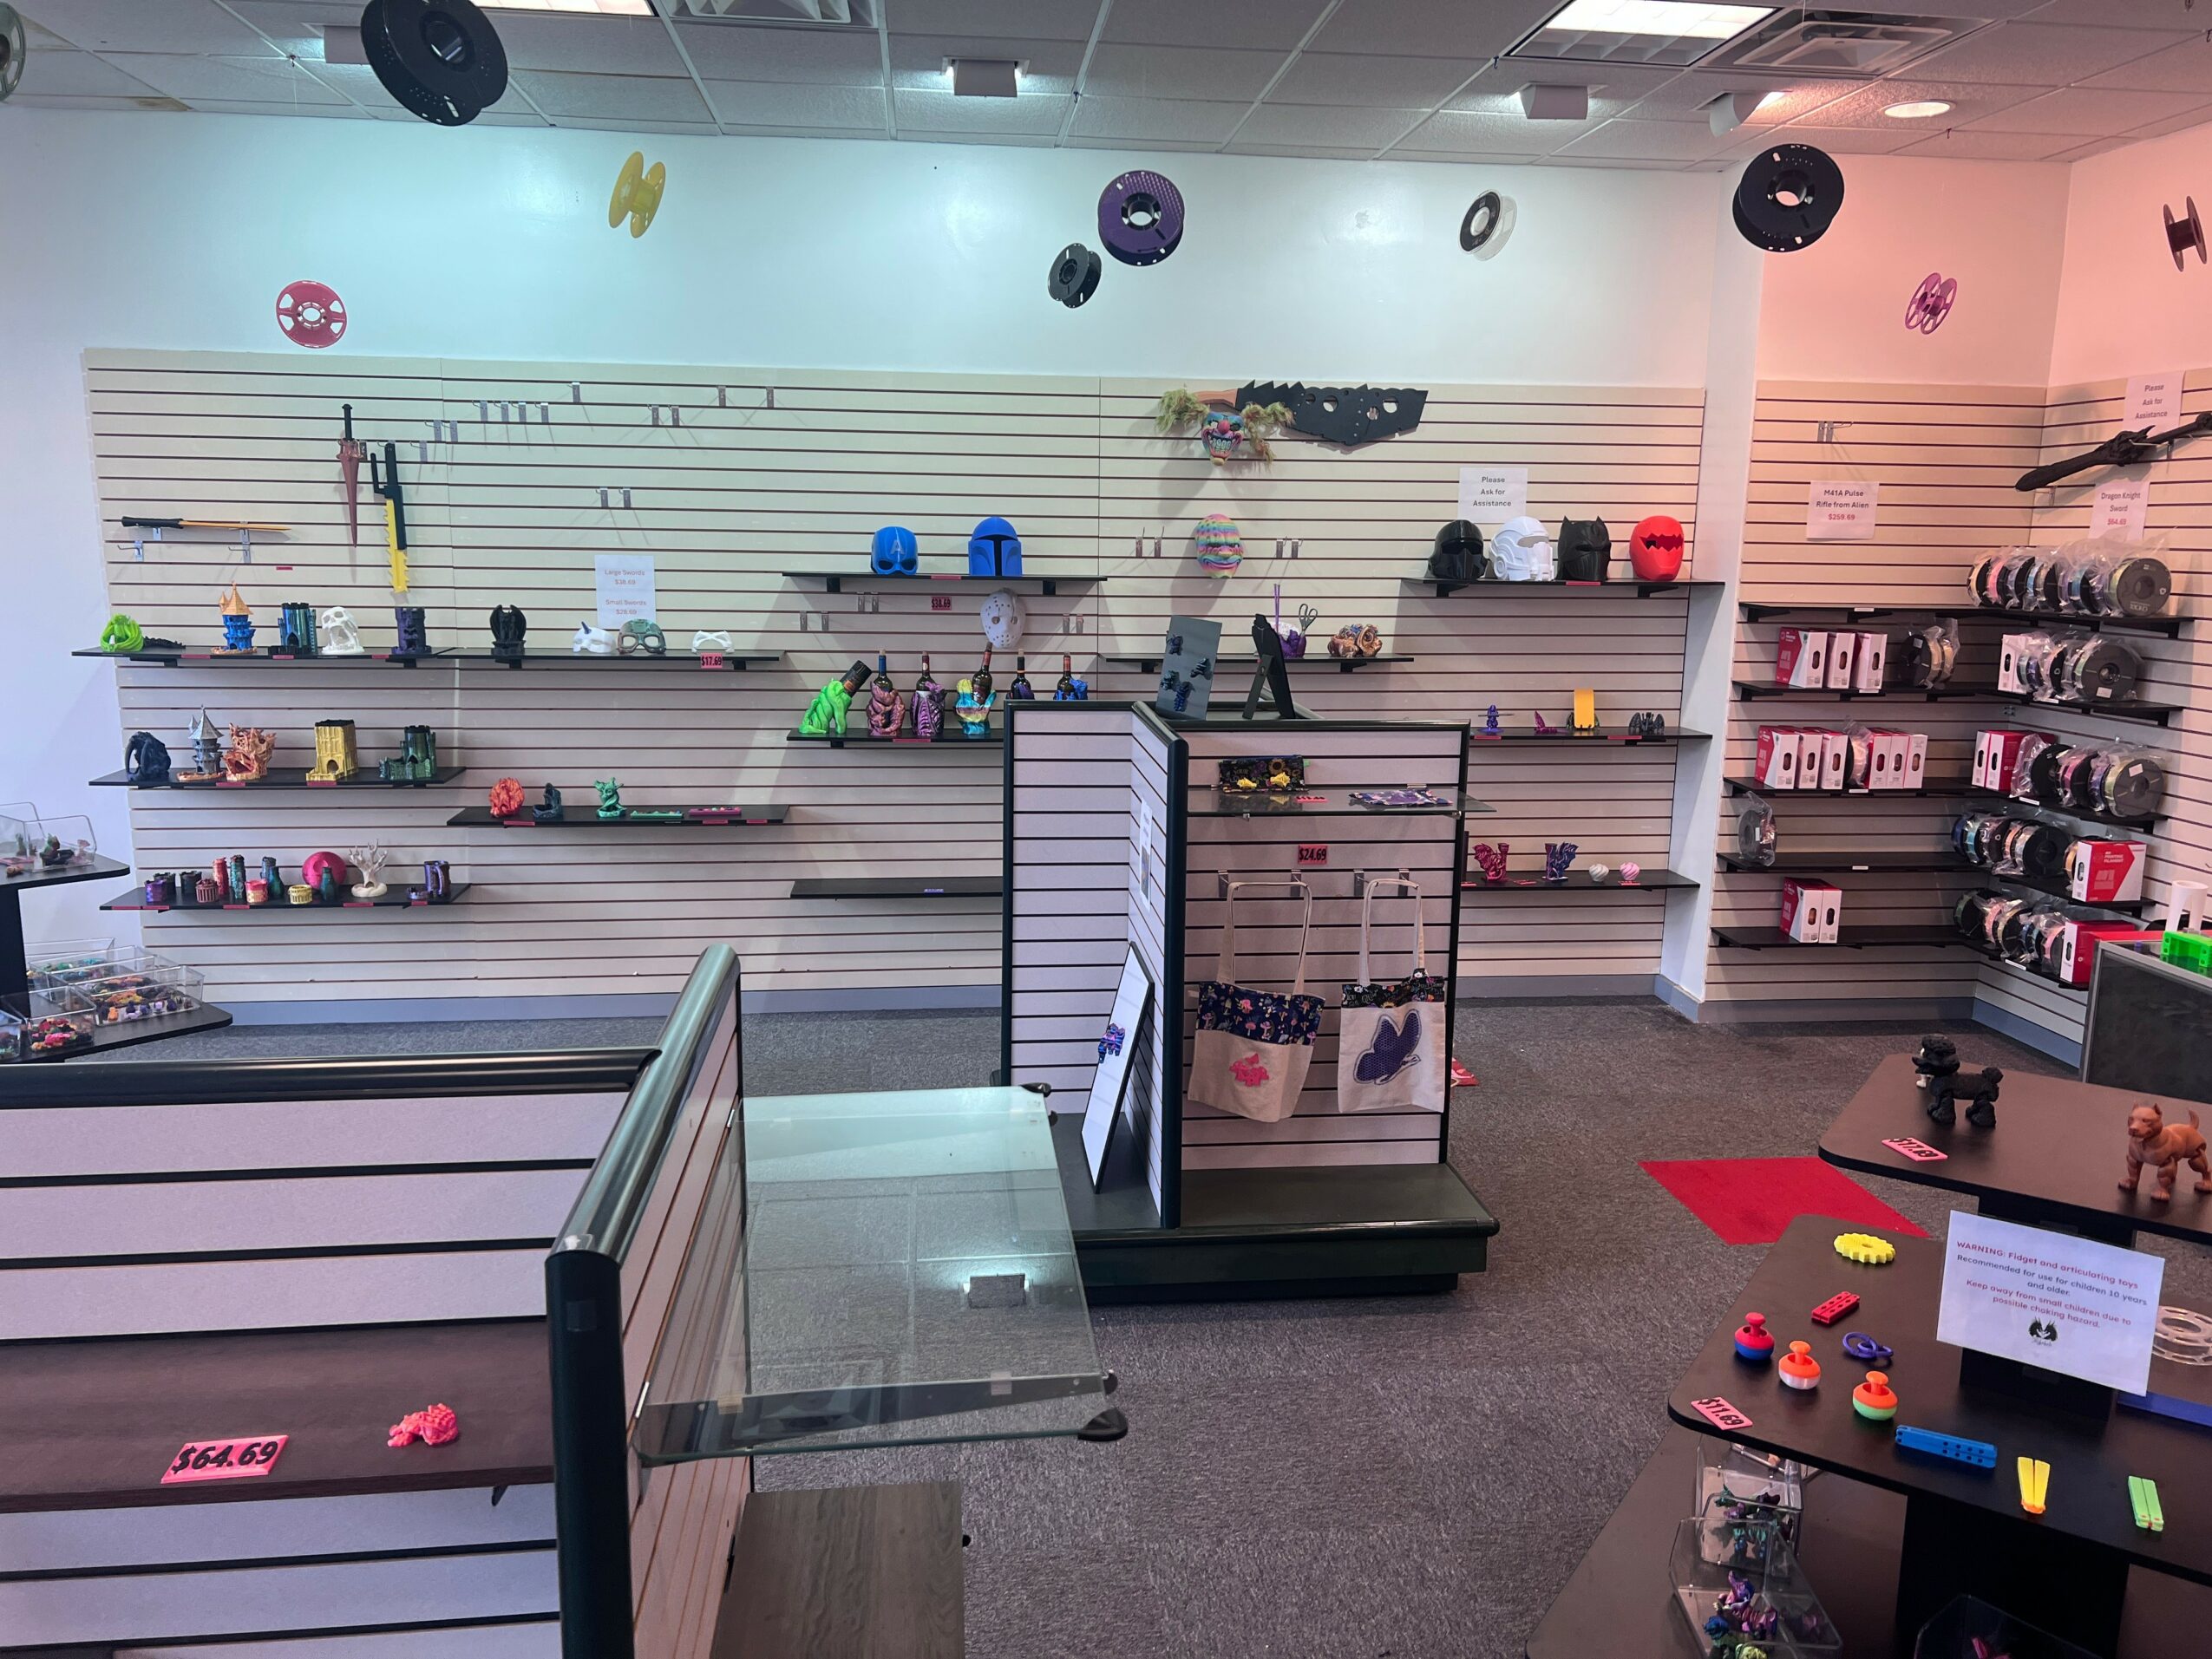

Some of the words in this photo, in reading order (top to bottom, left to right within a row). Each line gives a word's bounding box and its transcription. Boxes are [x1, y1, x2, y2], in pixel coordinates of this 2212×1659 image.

[702, 656, 722, 666] $17.69
[1299, 848, 1326, 860] $24.69
[1957, 1241, 2006, 1257] WARNING:
[2008, 1252, 2038, 1264] Fidget
[2040, 1259, 2058, 1270] and
[2060, 1264, 2116, 1284] articulating
[2118, 1277, 2138, 1289] toys
[1957, 1255, 2021, 1275] Recommended
[2023, 1268, 2036, 1278] for
[2038, 1273, 2053, 1282] use
[2056, 1276, 2069, 1286] for
[2071, 1280, 2107, 1296] children
[2110, 1290, 2120, 1298] 10
[2122, 1293, 2147, 1306] years
[2027, 1280, 2045, 1290] and
[1967, 1279, 1988, 1290] Keep
[1990, 1284, 2013, 1297] away
[2015, 1290, 2036, 1301] from
[2039, 1297, 2062, 1308] small
[2065, 1303, 2100, 1317] children
[2103, 1312, 2119, 1323] due
[2122, 1316, 2131, 1325] to
[1993, 1297, 2028, 1310] possible
[2031, 1306, 2065, 1320] choking
[2068, 1314, 2100, 1329] hazard.
[1698, 1399, 1744, 1426] $11.69
[172, 1441, 278, 1474] $64.69
